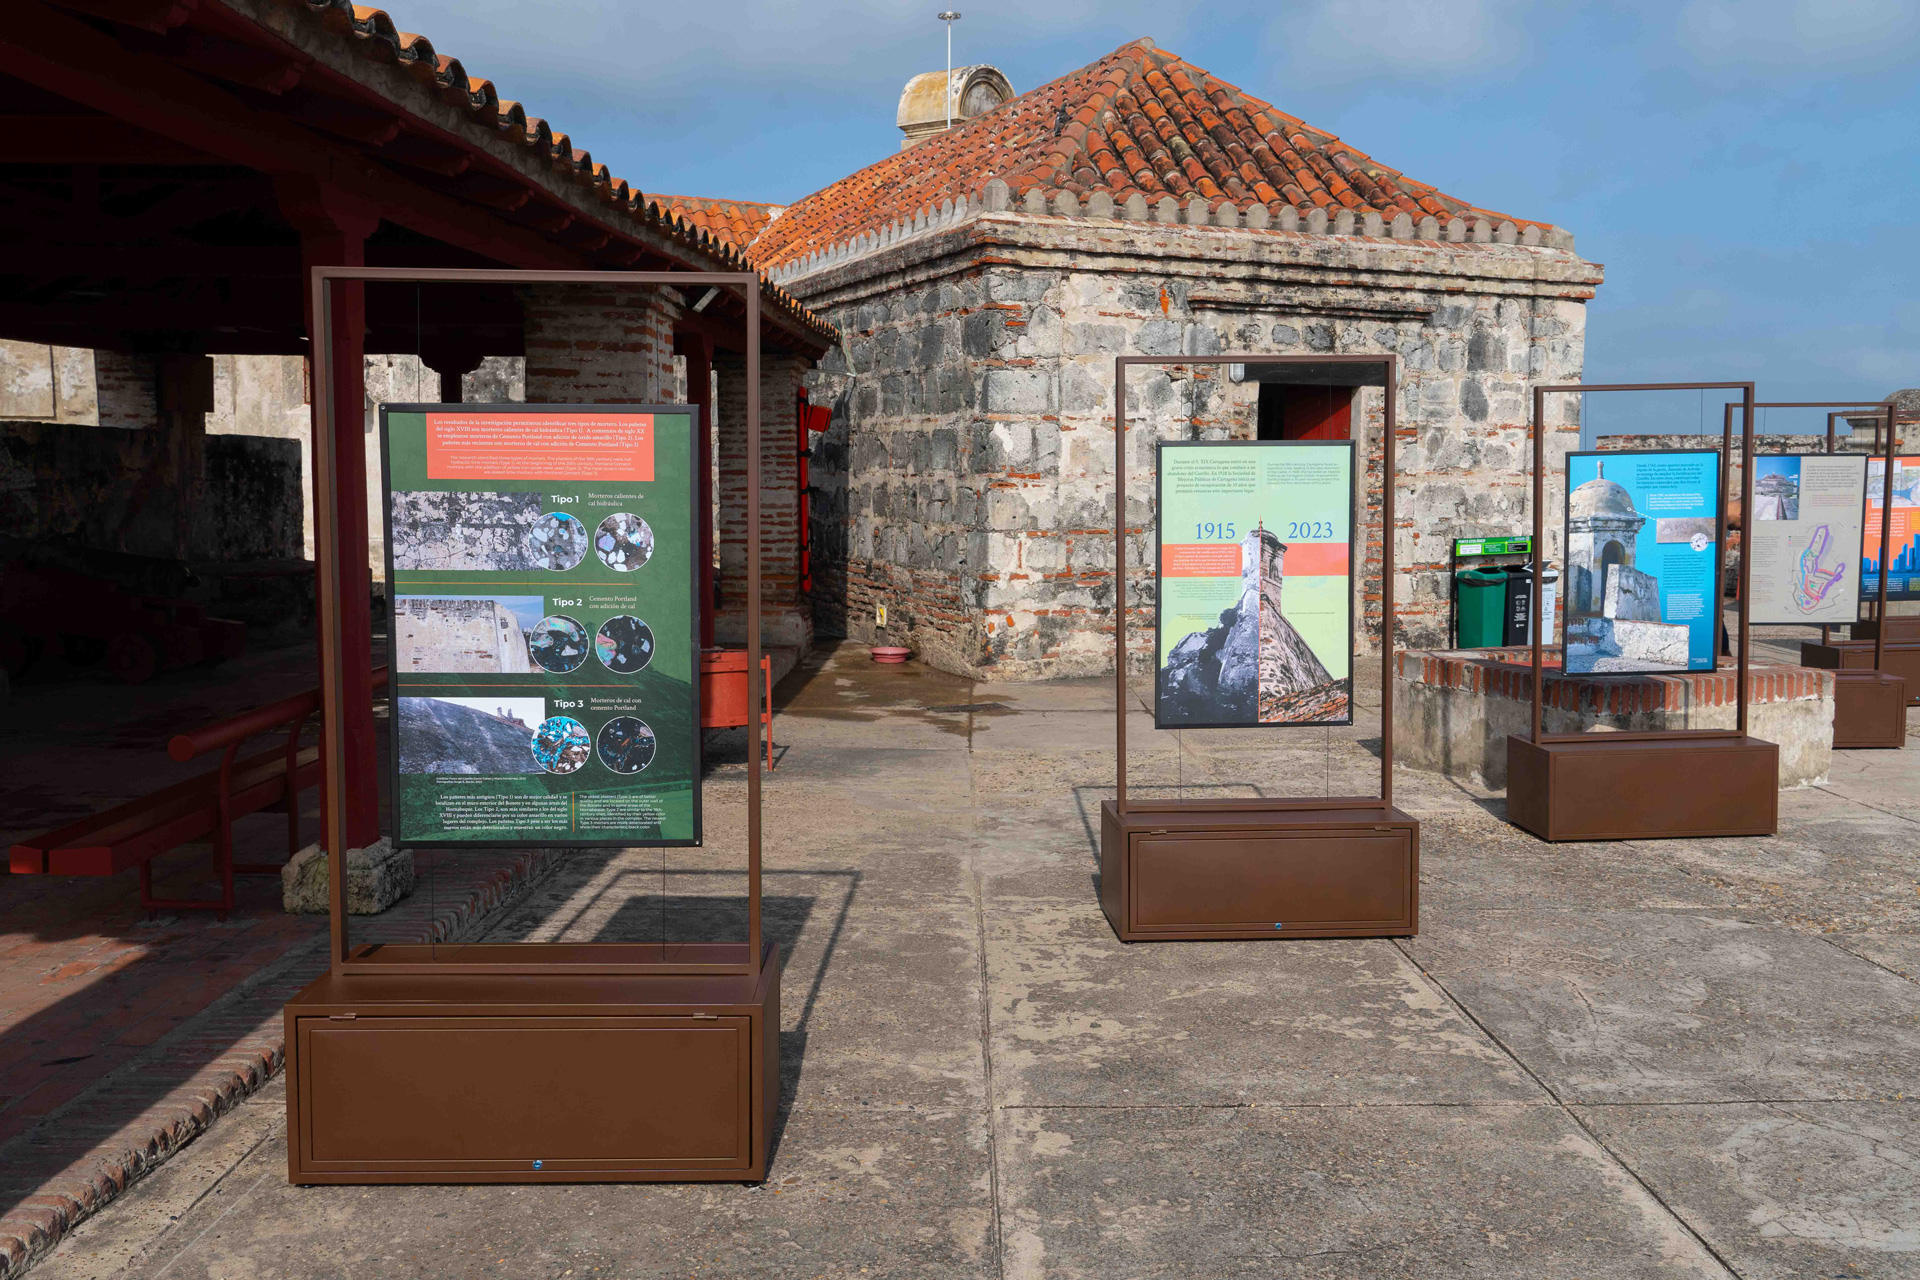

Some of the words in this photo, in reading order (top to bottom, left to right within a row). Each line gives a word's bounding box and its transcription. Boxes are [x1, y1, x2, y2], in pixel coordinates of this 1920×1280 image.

[551, 494, 573, 504] Tipo
[1195, 522, 1236, 540] 1915
[1288, 521, 1333, 539] 2023
[552, 598, 574, 607] Tipo
[554, 700, 576, 709] Tipo
